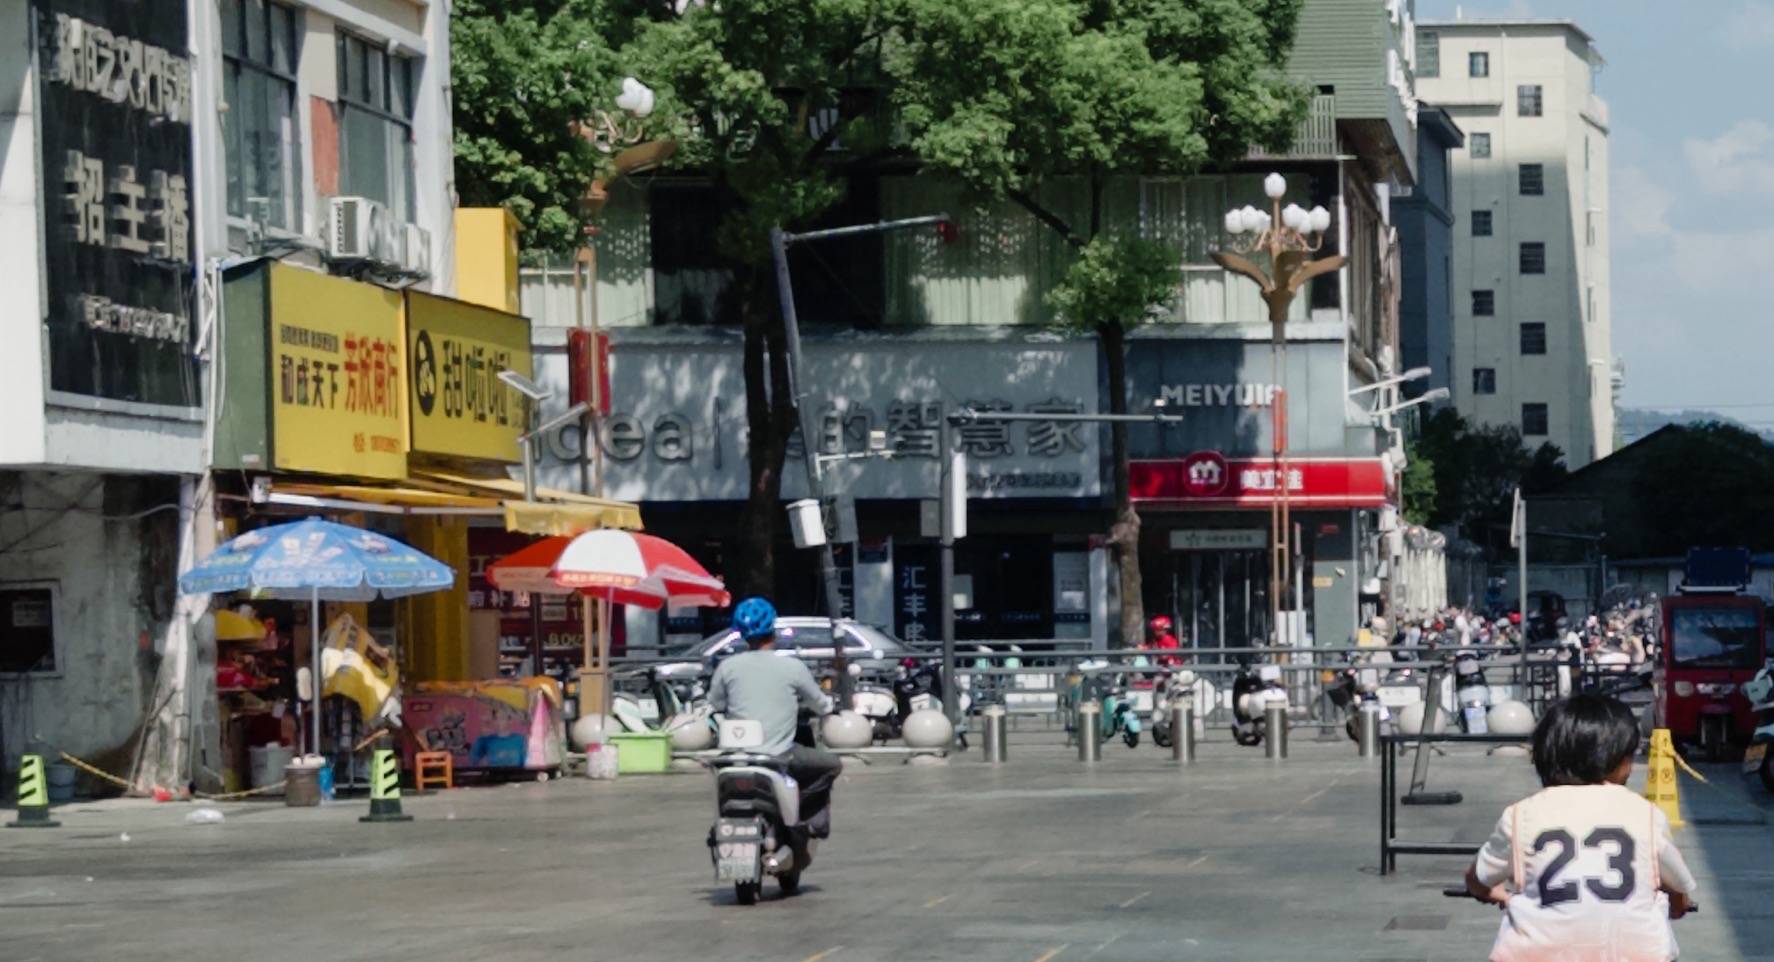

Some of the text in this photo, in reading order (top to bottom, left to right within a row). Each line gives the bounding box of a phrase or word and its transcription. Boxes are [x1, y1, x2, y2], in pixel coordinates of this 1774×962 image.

[64, 150, 189, 263] 招主播
[281, 354, 339, 410] 和成天下
[785, 398, 1086, 458] 的智慧家
[1534, 827, 1636, 905] 23
